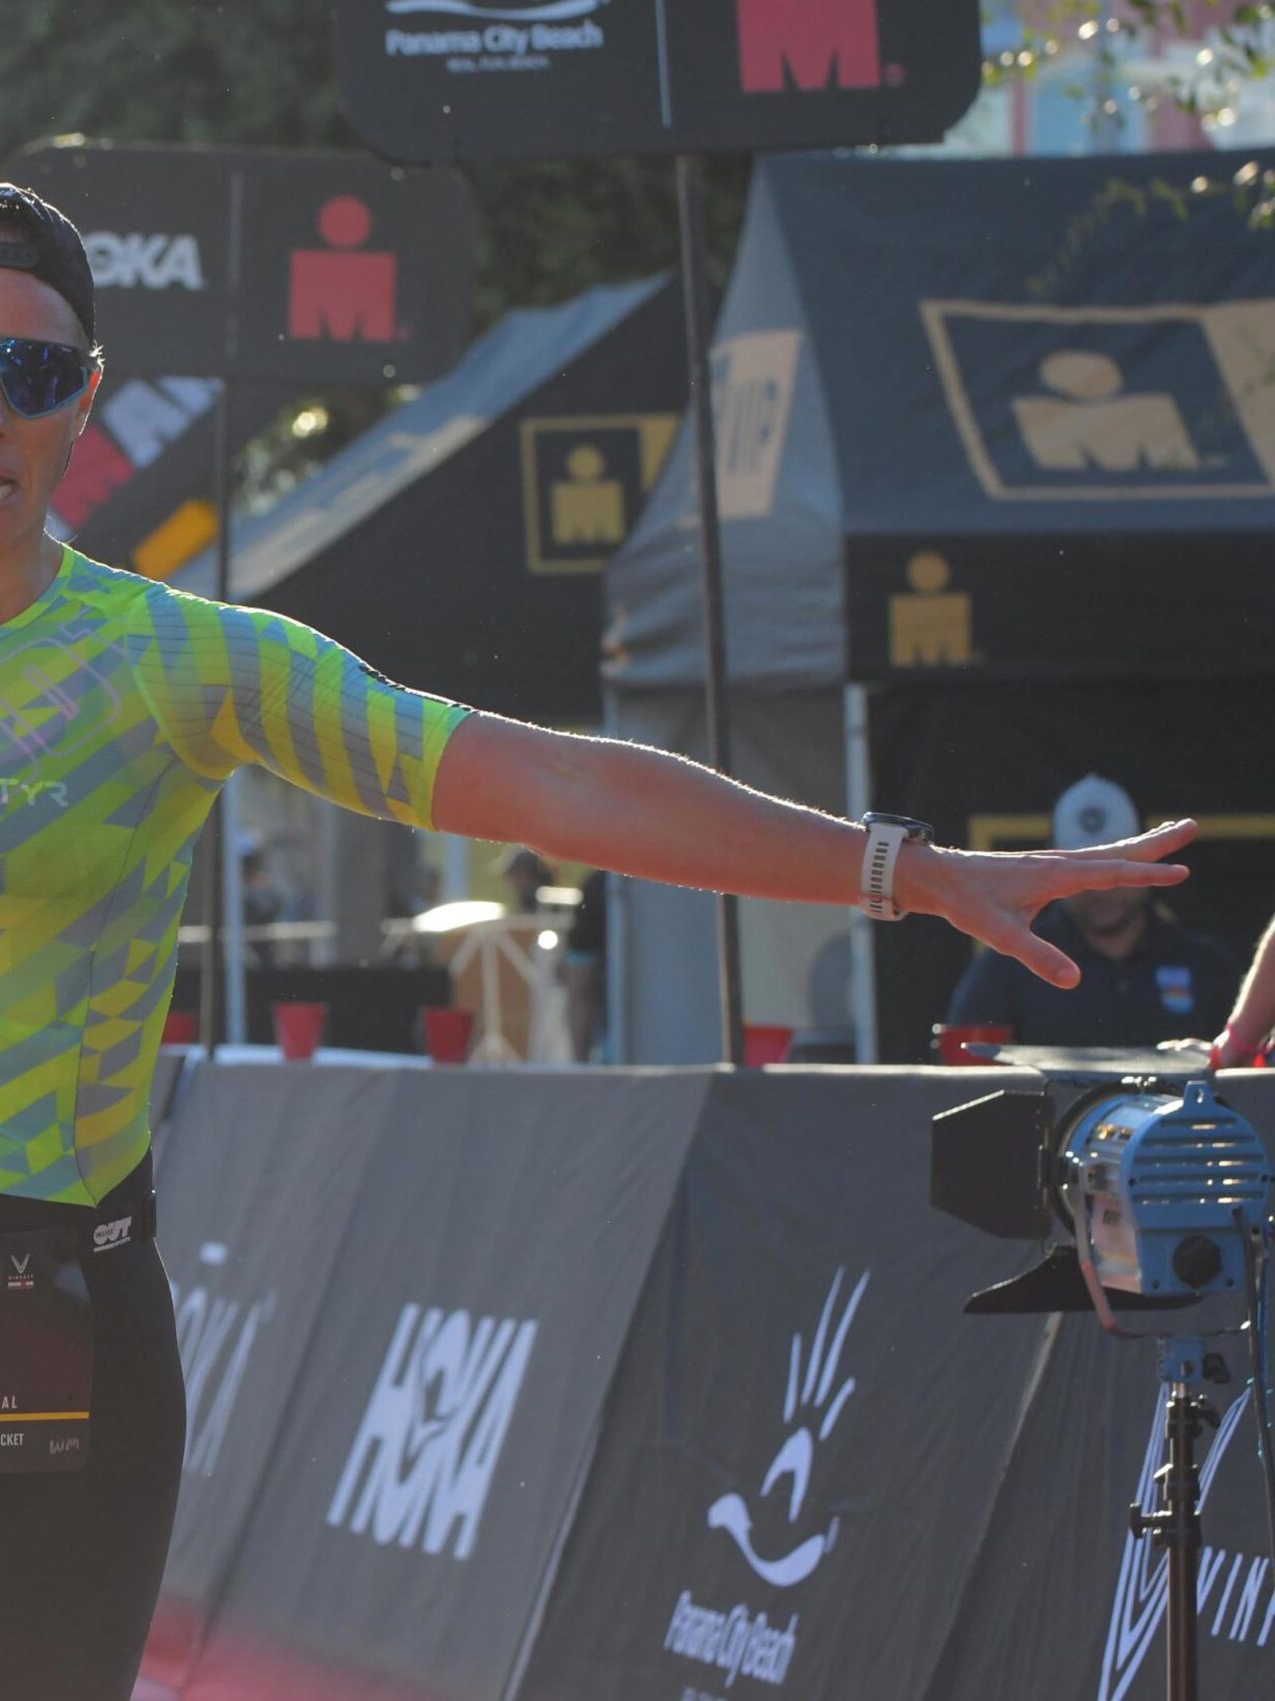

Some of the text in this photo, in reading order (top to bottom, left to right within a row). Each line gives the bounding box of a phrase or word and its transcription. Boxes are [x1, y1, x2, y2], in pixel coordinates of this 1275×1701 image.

[386, 18, 604, 56] Panama City Beach
[82, 231, 204, 290] OKA
[326, 1302, 538, 1560] HOKA
[663, 1589, 726, 1665] Panama
[740, 1612, 800, 1685] Beach
